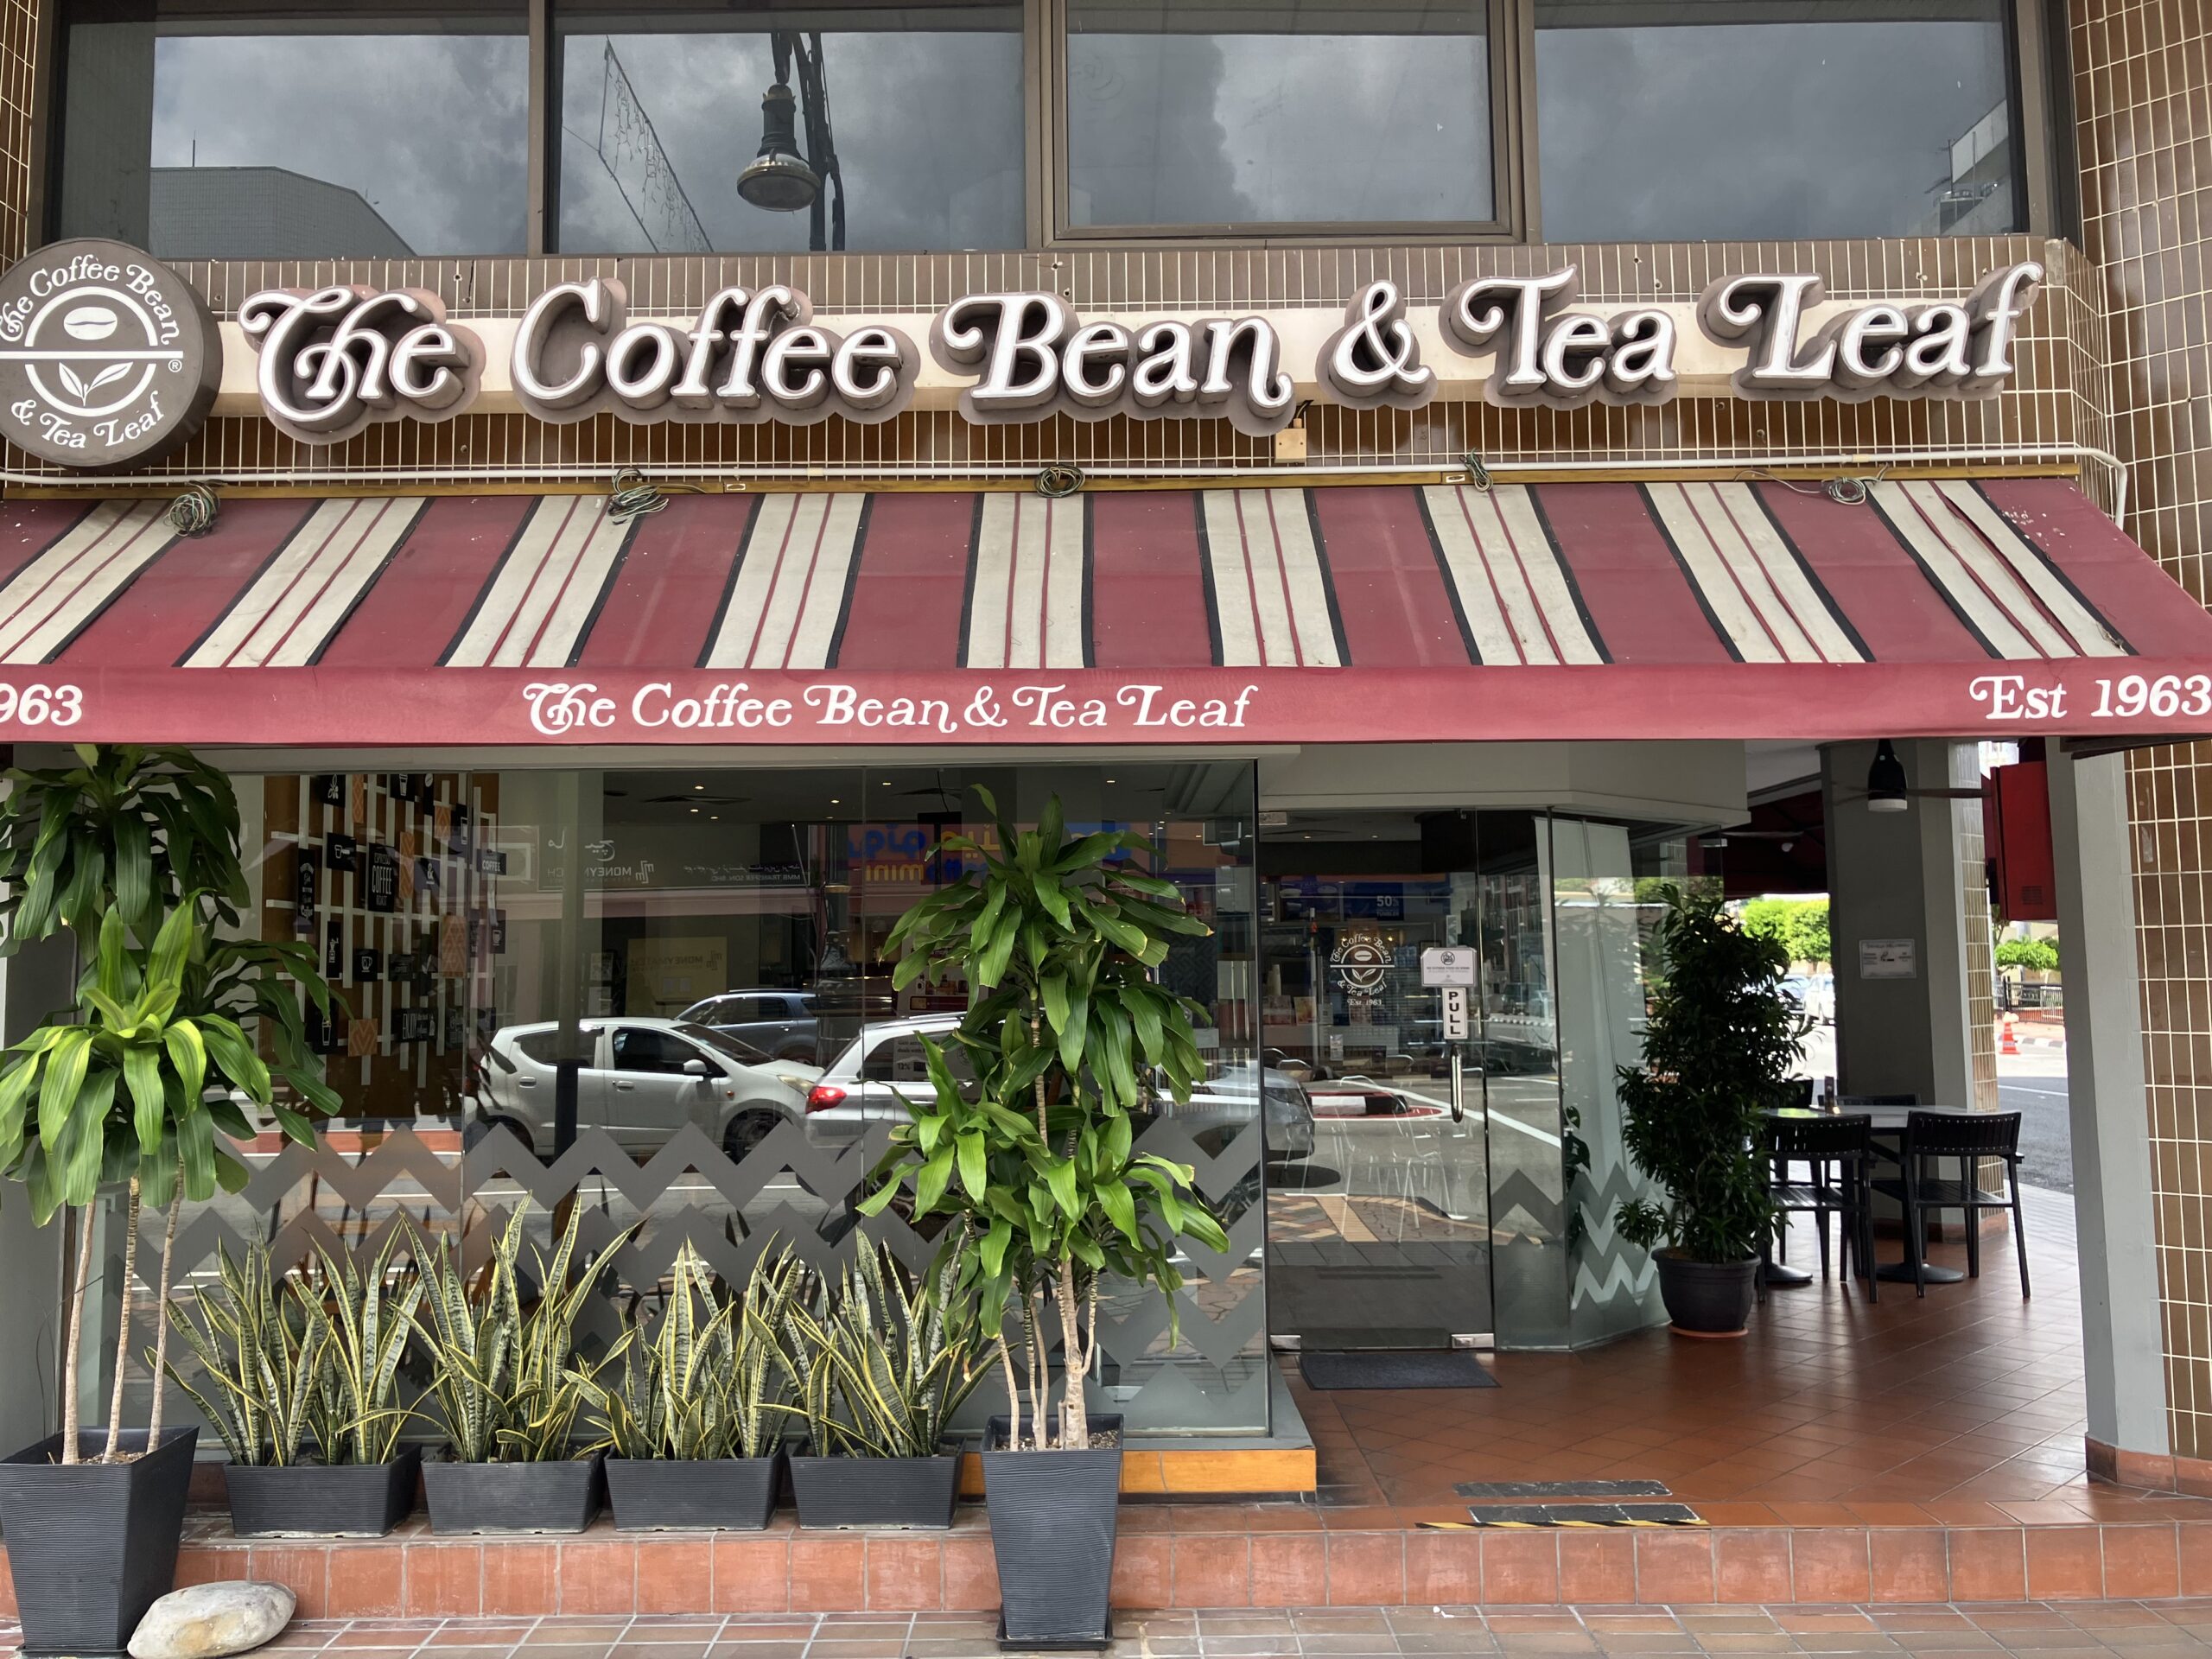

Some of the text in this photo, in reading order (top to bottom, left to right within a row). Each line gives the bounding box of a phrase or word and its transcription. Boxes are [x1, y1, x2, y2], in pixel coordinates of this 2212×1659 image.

[0, 254, 180, 346] The Coffee Bean
[237, 261, 2045, 423] The Coffee Bean & Tea Leaf
[11, 391, 164, 448] & Tea Leaf
[522, 682, 1258, 734] The Coffee Bean & Tea Leaf
[1968, 674, 2212, 720] Est 1963
[372, 865, 392, 895] COFFEE
[481, 860, 501, 872] COFFEE
[1329, 934, 1392, 963] The Coffee Bean
[1347, 984, 1363, 996] Tea
[1363, 978, 1387, 995] Leaf
[1448, 991, 1461, 1035] PULL
